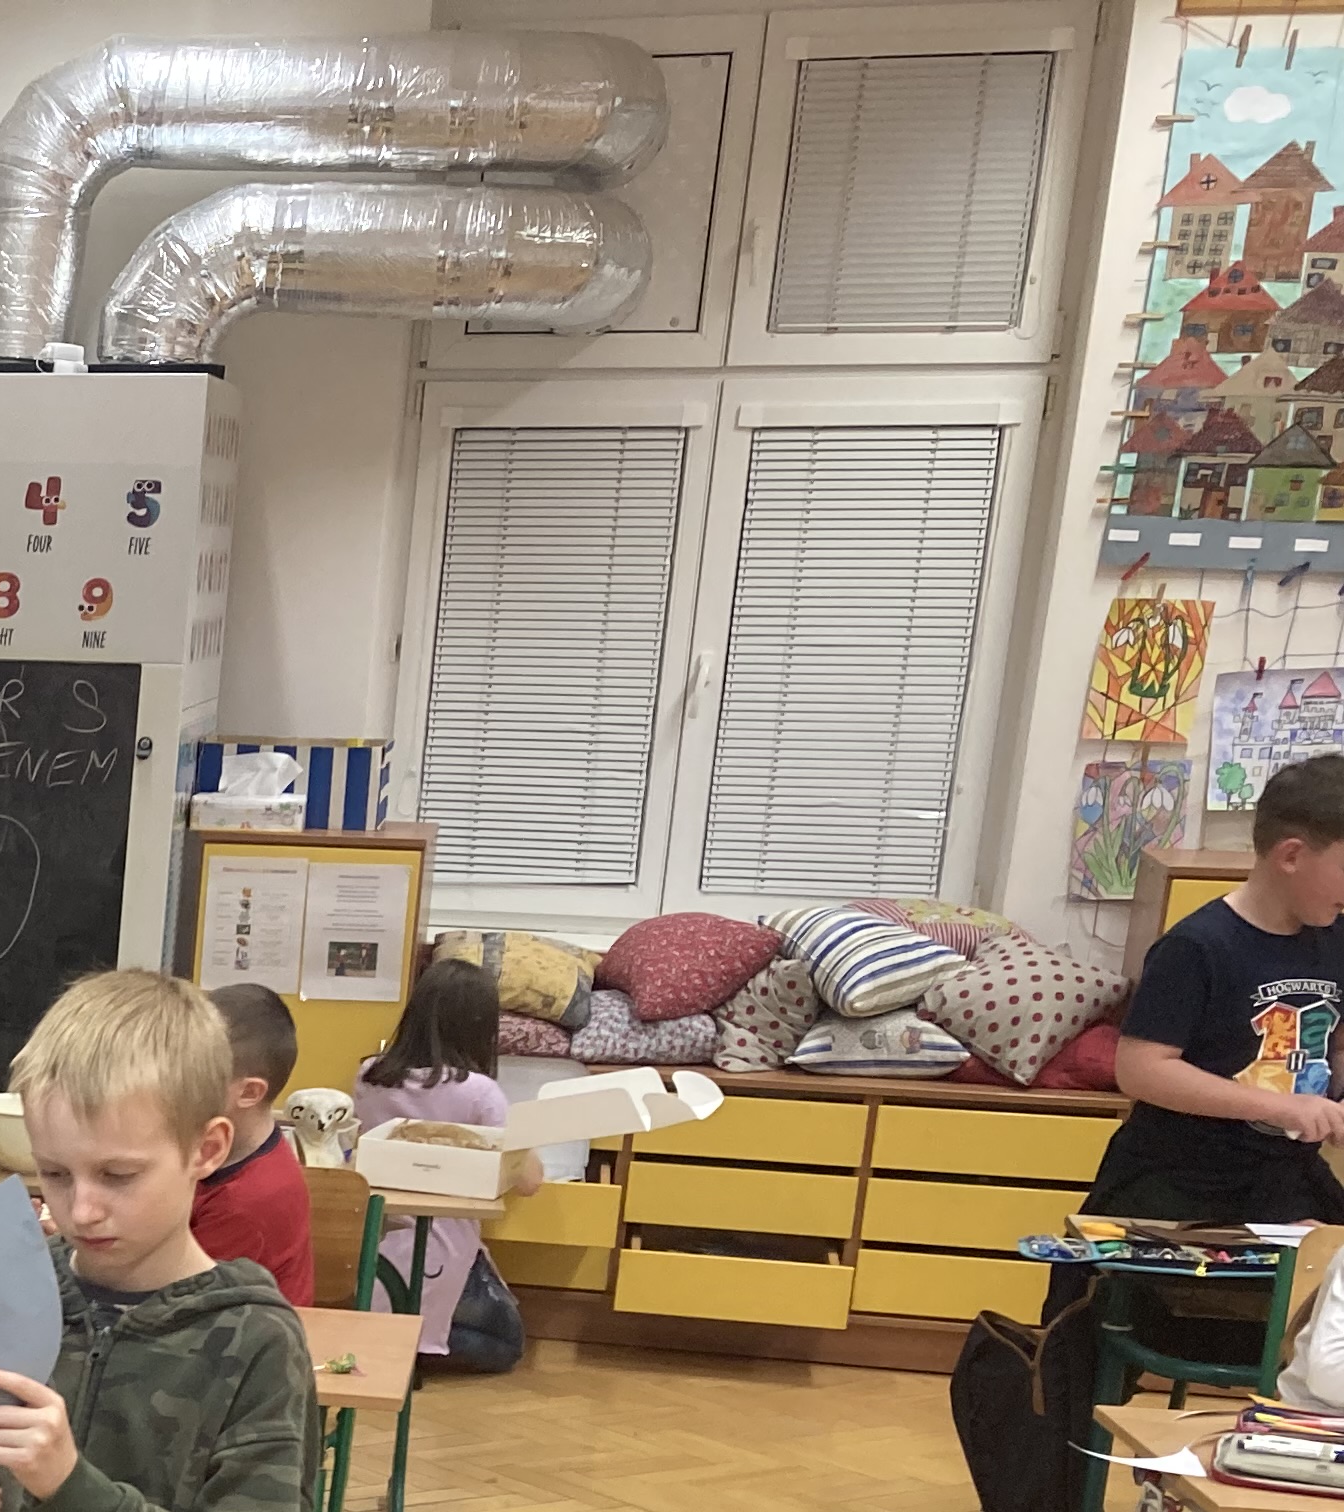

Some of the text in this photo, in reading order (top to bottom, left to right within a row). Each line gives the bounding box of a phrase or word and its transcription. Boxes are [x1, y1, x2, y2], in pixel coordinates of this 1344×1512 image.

[26, 533, 53, 554] FOUR
[127, 536, 151, 556] FIVE
[81, 630, 108, 650] NINE
[64, 679, 108, 733] S
[1266, 981, 1331, 996] HOGWARTS
